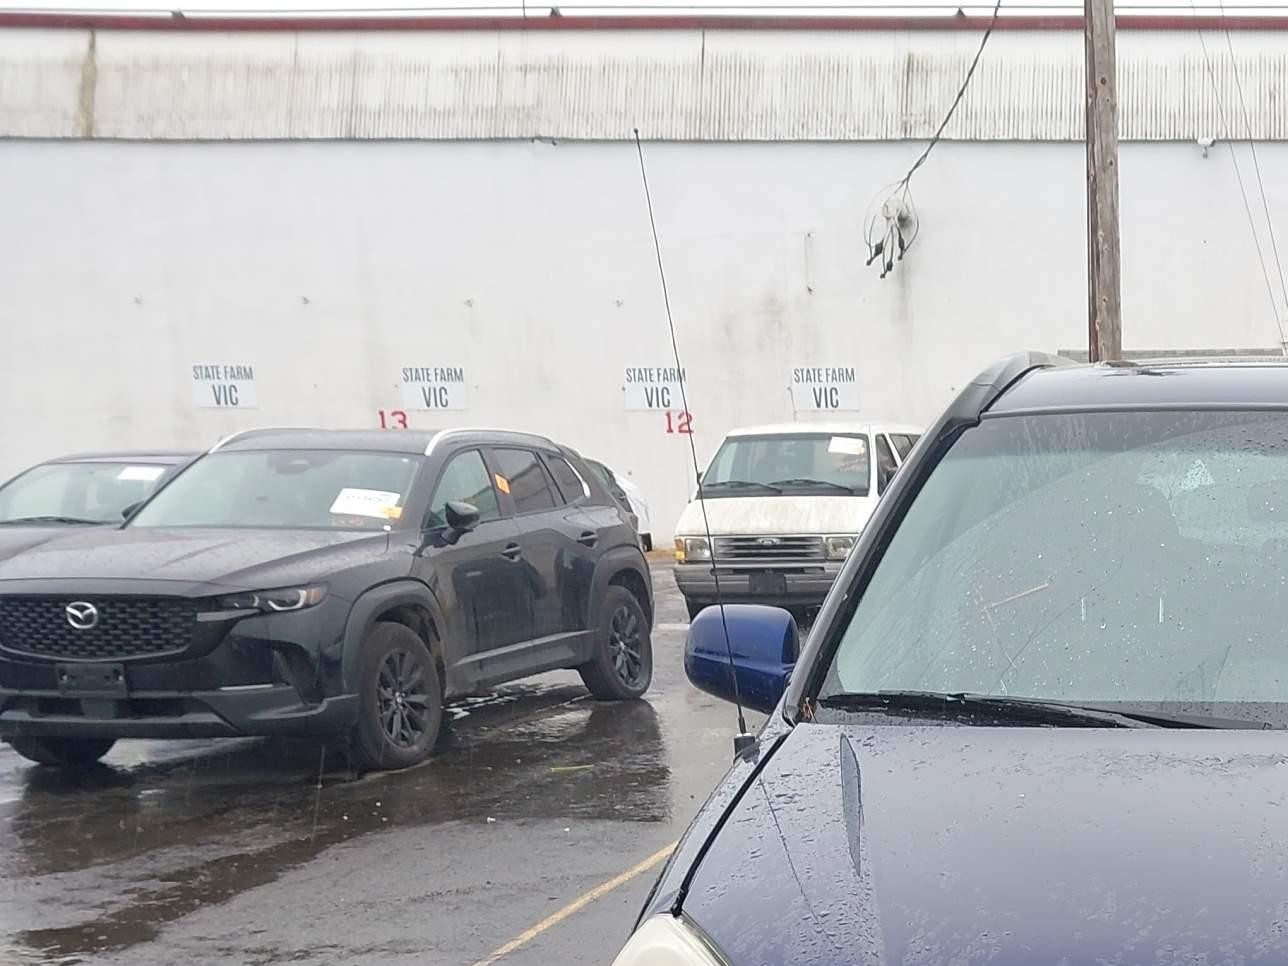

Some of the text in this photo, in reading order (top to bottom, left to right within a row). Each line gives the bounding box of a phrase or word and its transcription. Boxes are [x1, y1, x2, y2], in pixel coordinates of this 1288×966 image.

[192, 365, 254, 381] STATE FARM
[402, 367, 464, 383] STATE FARM
[625, 367, 686, 383] STATE FARM
[793, 367, 856, 383] STATE FARM
[211, 384, 239, 406] VIC
[421, 386, 449, 408] VIC
[644, 386, 671, 408] VIC
[812, 386, 840, 409] VIC
[664, 410, 695, 434] 12
